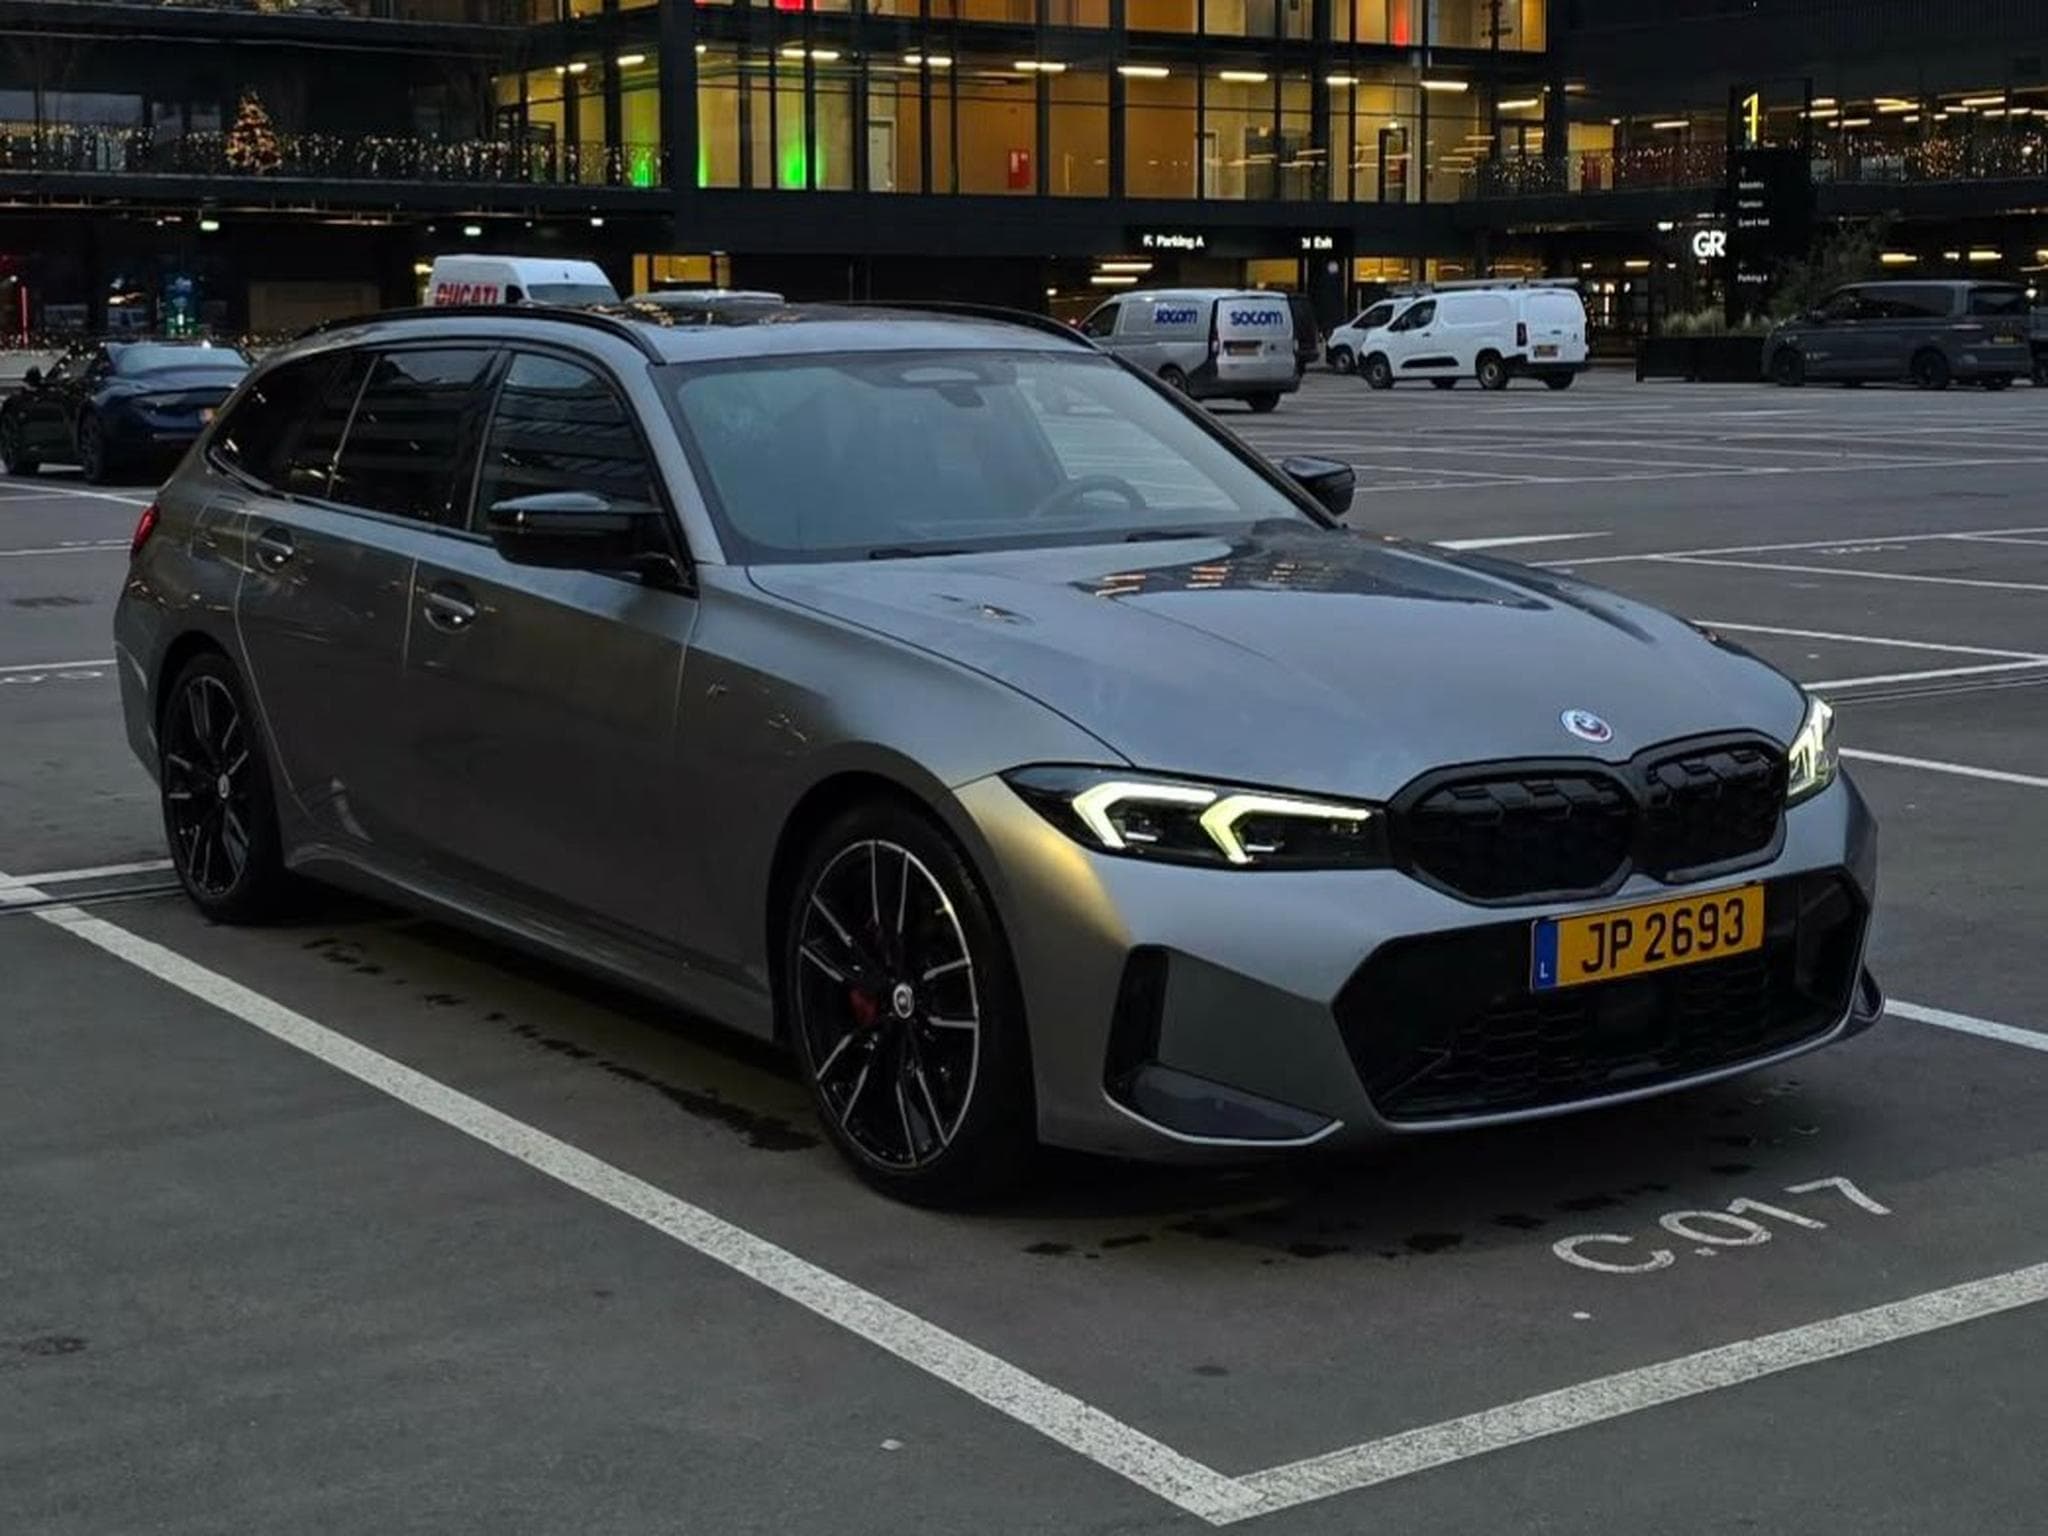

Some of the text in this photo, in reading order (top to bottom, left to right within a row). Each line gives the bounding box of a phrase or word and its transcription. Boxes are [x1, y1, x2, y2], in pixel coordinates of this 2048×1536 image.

[1741, 92, 1759, 143] 1
[1156, 234, 1205, 250] Parking A
[1313, 235, 1333, 249] Exit
[1692, 230, 1727, 257] GR
[436, 282, 499, 305] DUCATI
[1154, 308, 1198, 325] socom
[1230, 309, 1284, 326] socom
[1582, 898, 1744, 973] JP 2693
[1539, 963, 1549, 979] L
[1552, 1176, 1892, 1273] C.017
